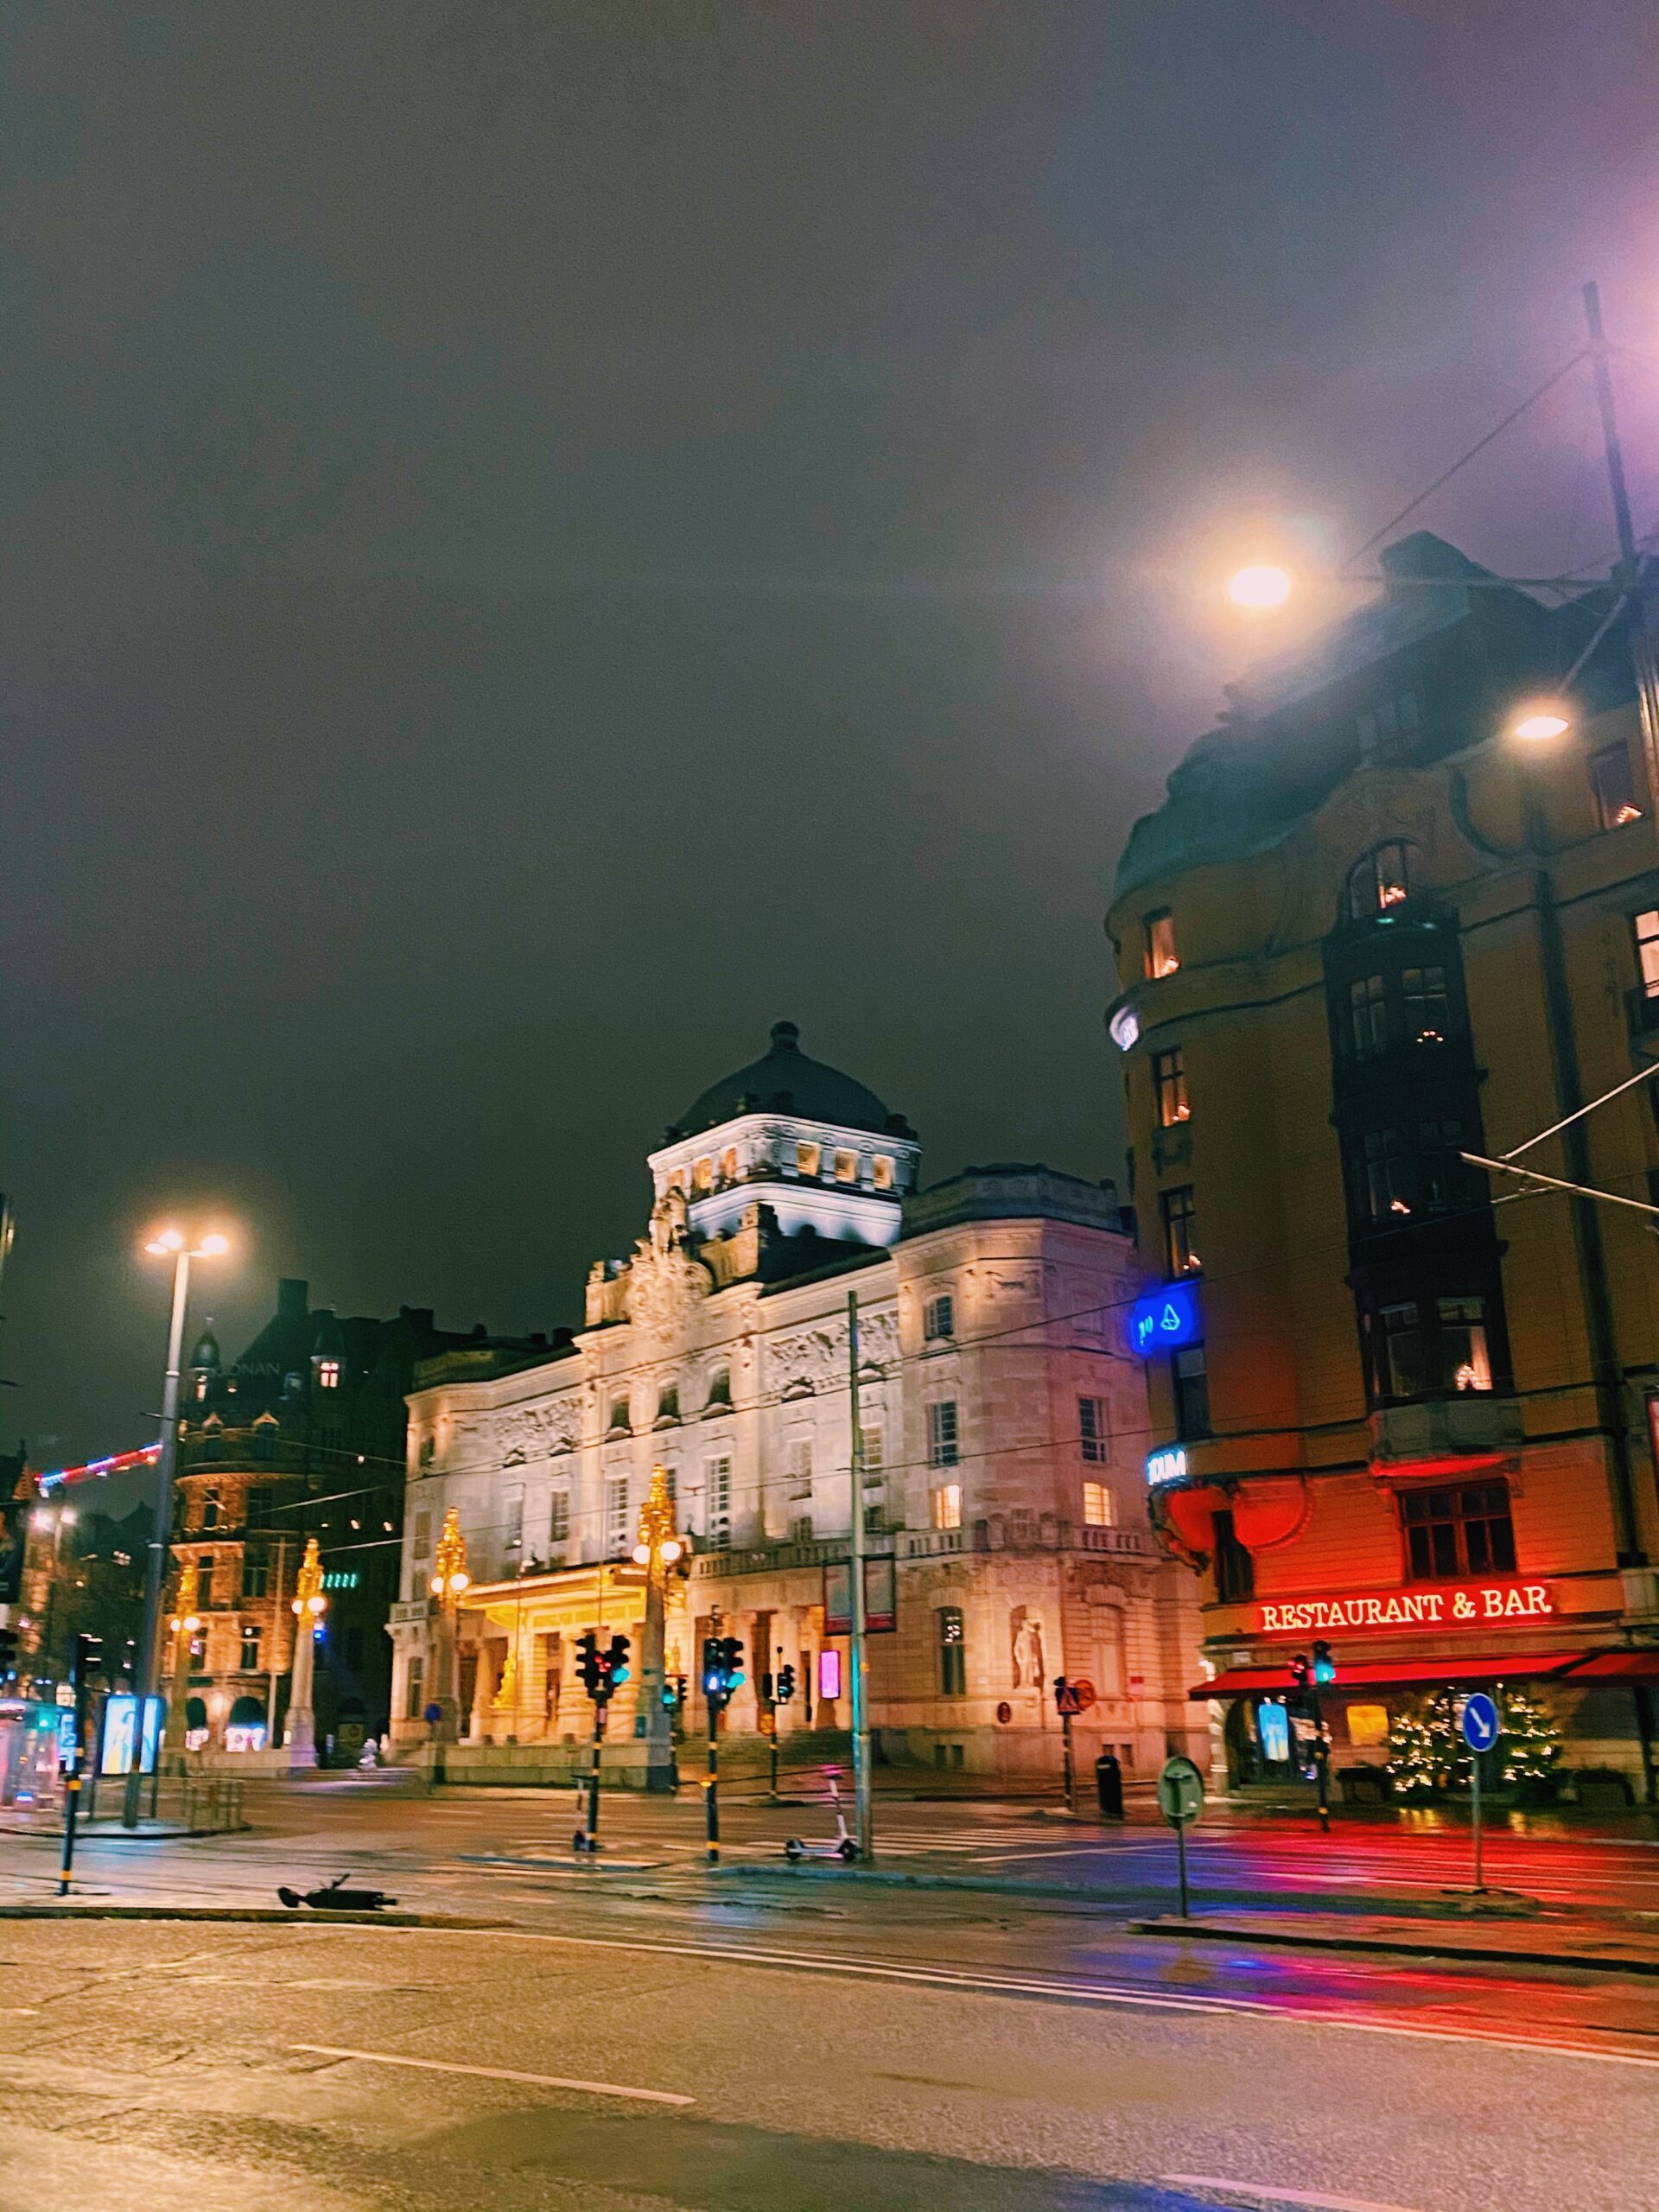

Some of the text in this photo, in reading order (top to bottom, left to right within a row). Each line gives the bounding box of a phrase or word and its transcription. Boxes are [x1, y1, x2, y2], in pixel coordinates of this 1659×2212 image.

[1261, 1586, 1552, 1630] RESTAURANT & BAR
